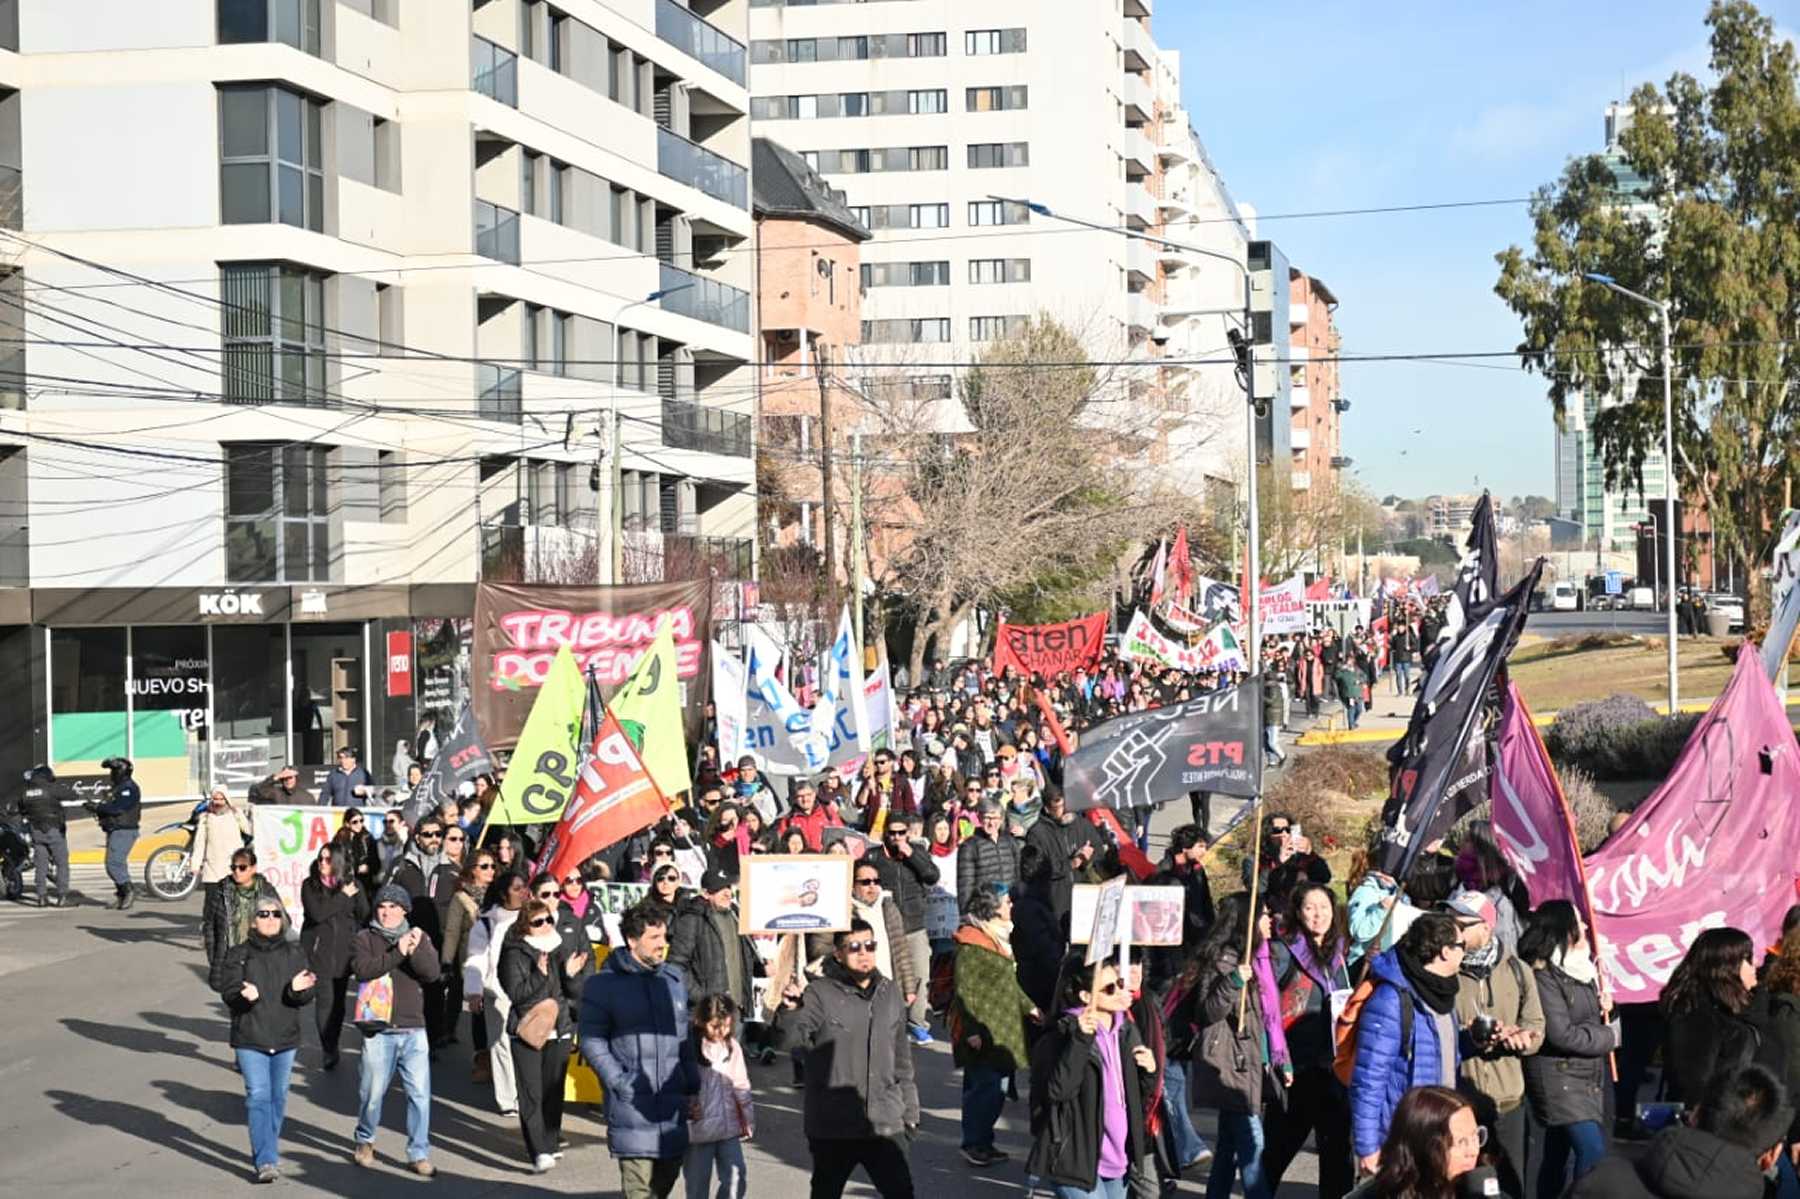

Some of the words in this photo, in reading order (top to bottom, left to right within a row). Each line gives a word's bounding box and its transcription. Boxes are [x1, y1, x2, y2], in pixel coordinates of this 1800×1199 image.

[199, 588, 264, 615] KÖK
[501, 606, 695, 650] TRIBUNA
[1008, 624, 1087, 653] aten
[495, 642, 702, 690] DOENE
[124, 677, 185, 695] NUEVO
